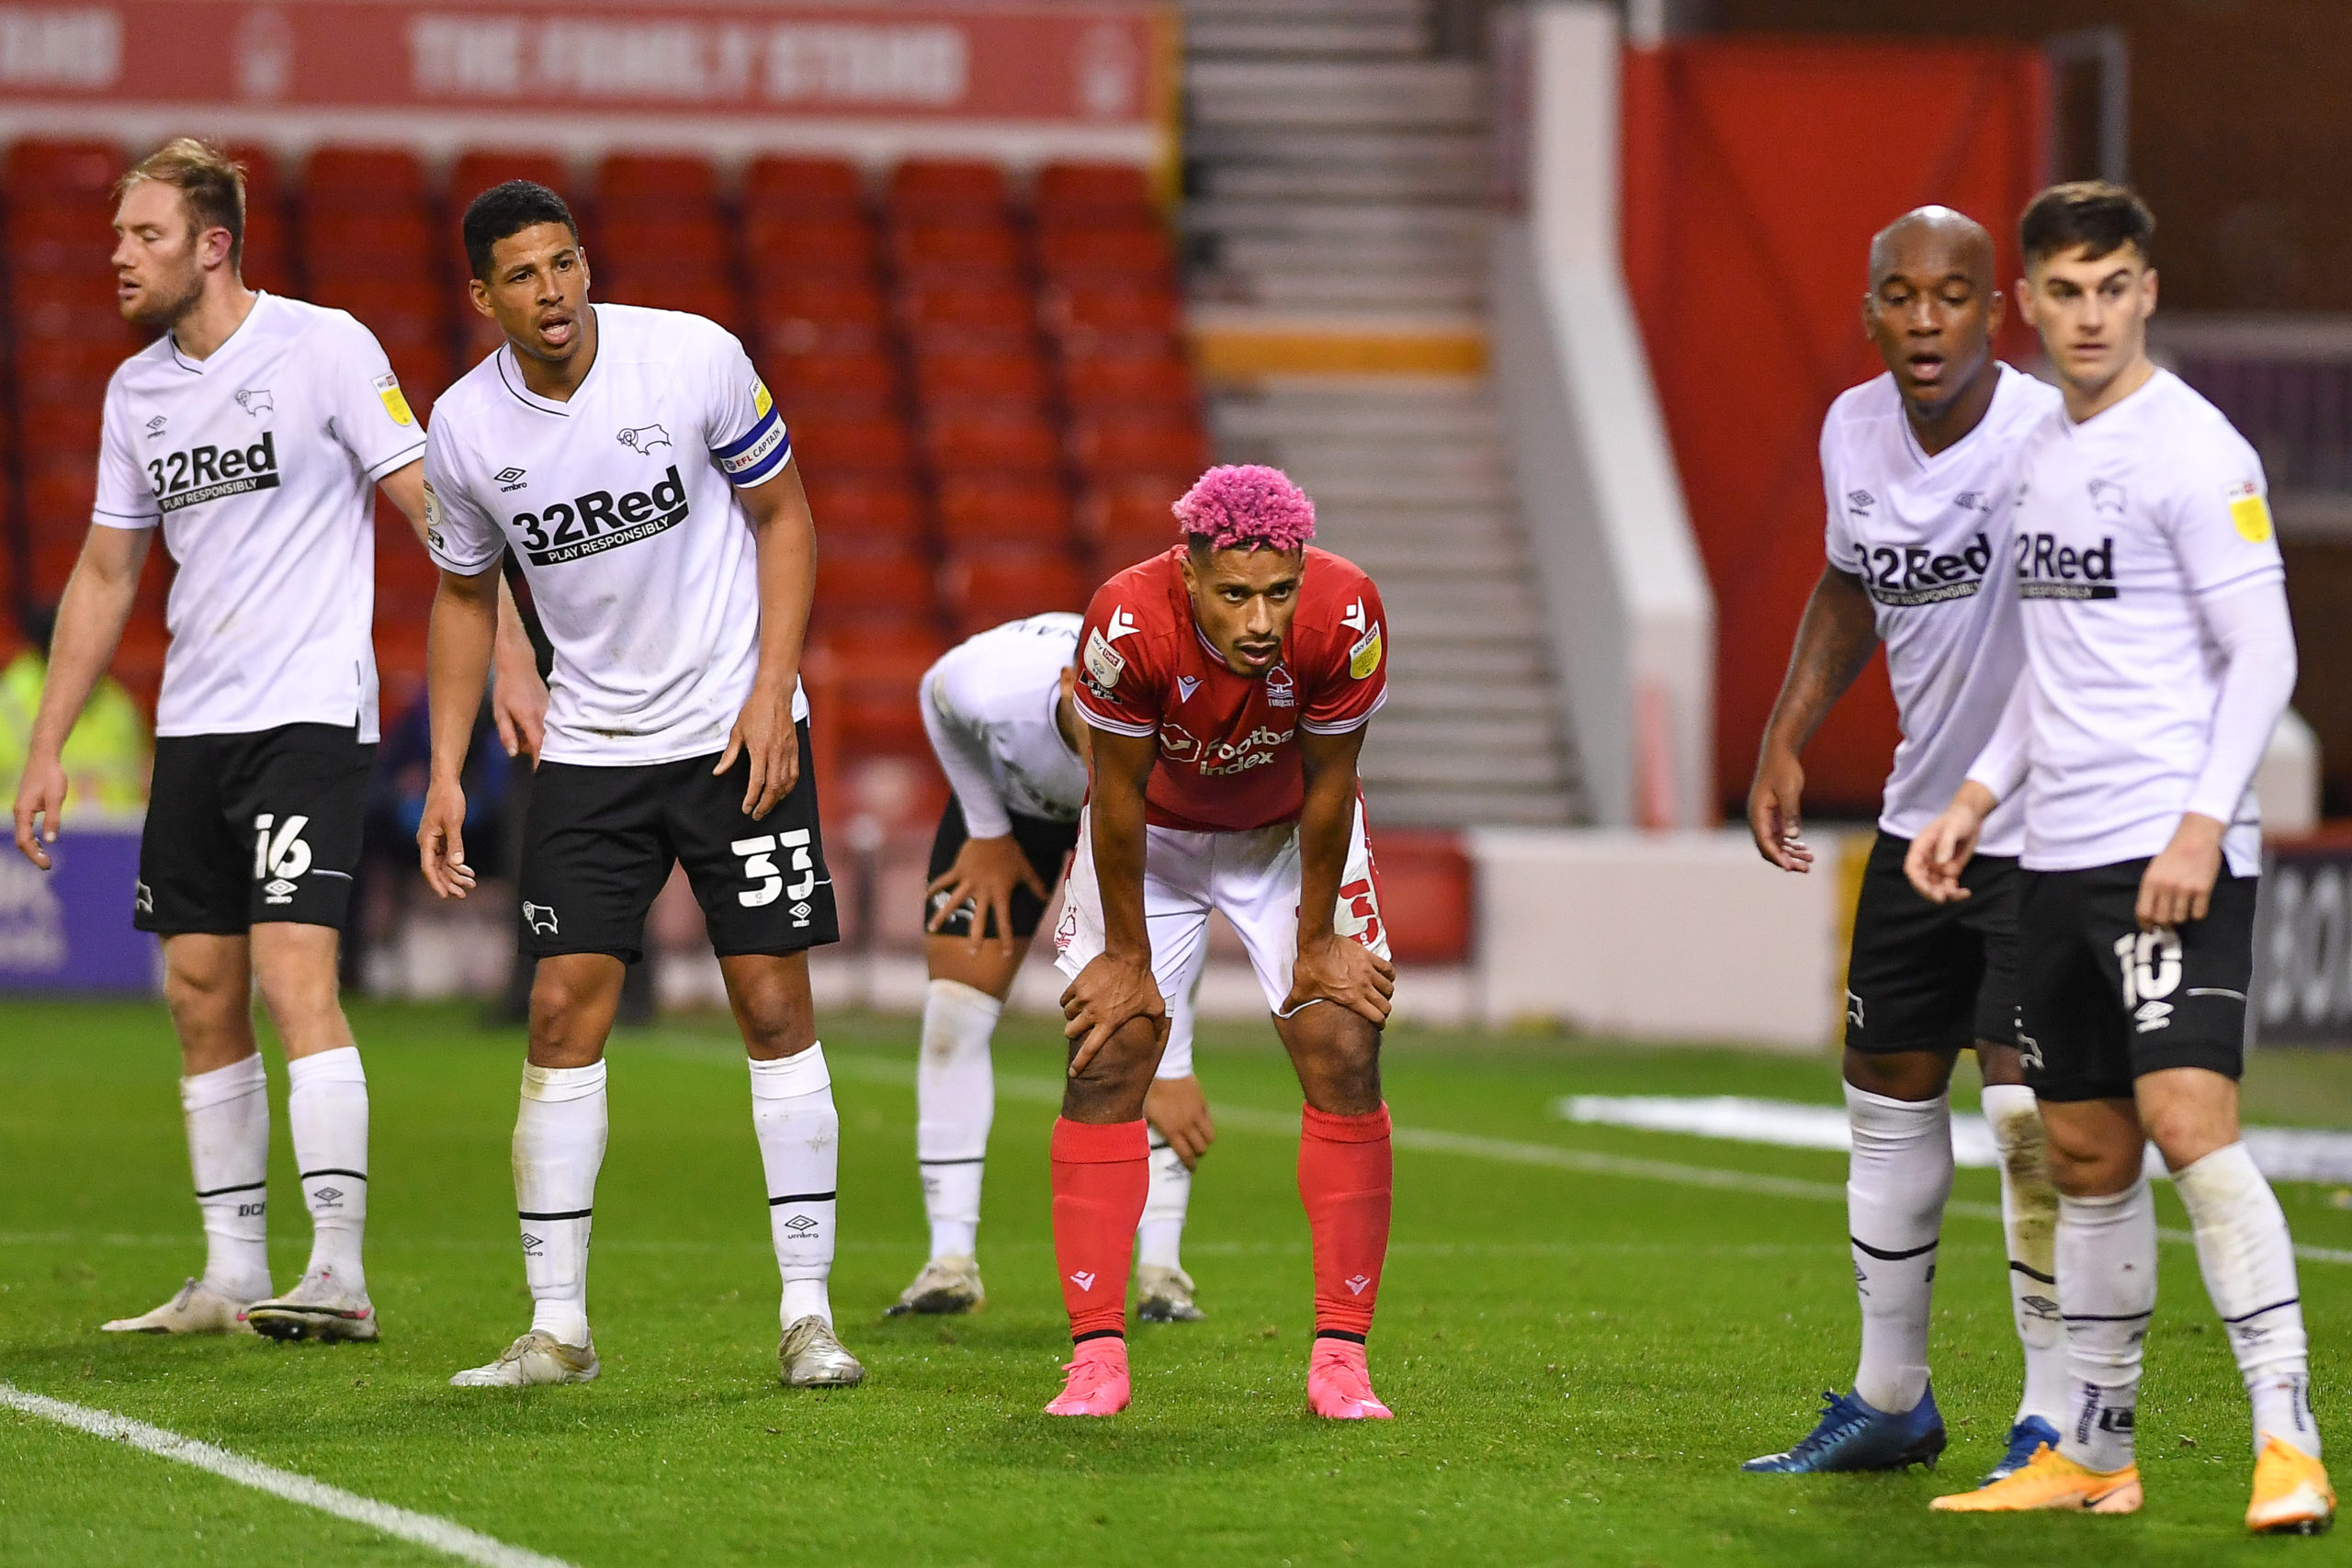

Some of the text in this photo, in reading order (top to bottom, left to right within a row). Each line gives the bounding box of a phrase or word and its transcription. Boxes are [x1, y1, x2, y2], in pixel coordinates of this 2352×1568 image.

[147, 431, 277, 497] 32Red
[735, 427, 781, 467] EFL CAPTAIN
[163, 479, 258, 510] PLAY RESPONSIBLY
[501, 481, 527, 493] umbro
[512, 464, 686, 551] 32Red
[548, 516, 670, 562] PLAY RESPONSIBLY
[1854, 533, 1991, 590] 32Red
[2016, 534, 2114, 581] 2Red
[1093, 636, 1119, 666] sky bet
[1199, 750, 1275, 776] Index
[1204, 726, 1295, 760] Footba
[254, 813, 312, 879] 16
[731, 828, 815, 908] 33
[2114, 926, 2183, 1010] 10
